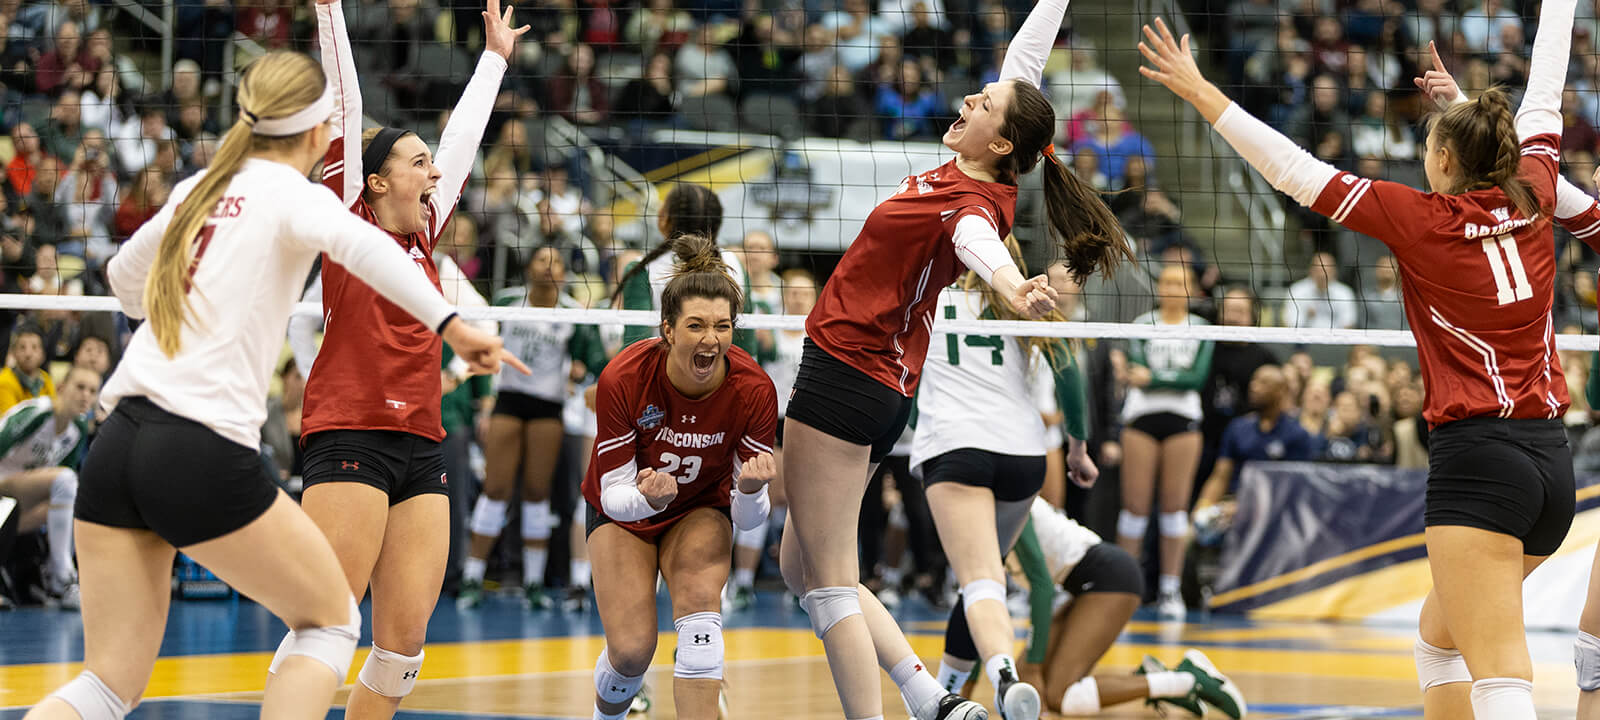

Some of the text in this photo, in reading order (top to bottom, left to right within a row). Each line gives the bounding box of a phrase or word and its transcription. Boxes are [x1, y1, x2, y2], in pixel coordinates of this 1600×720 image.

[1481, 233, 1534, 306] 11
[943, 305, 1004, 366] 14
[656, 452, 703, 484] 23
